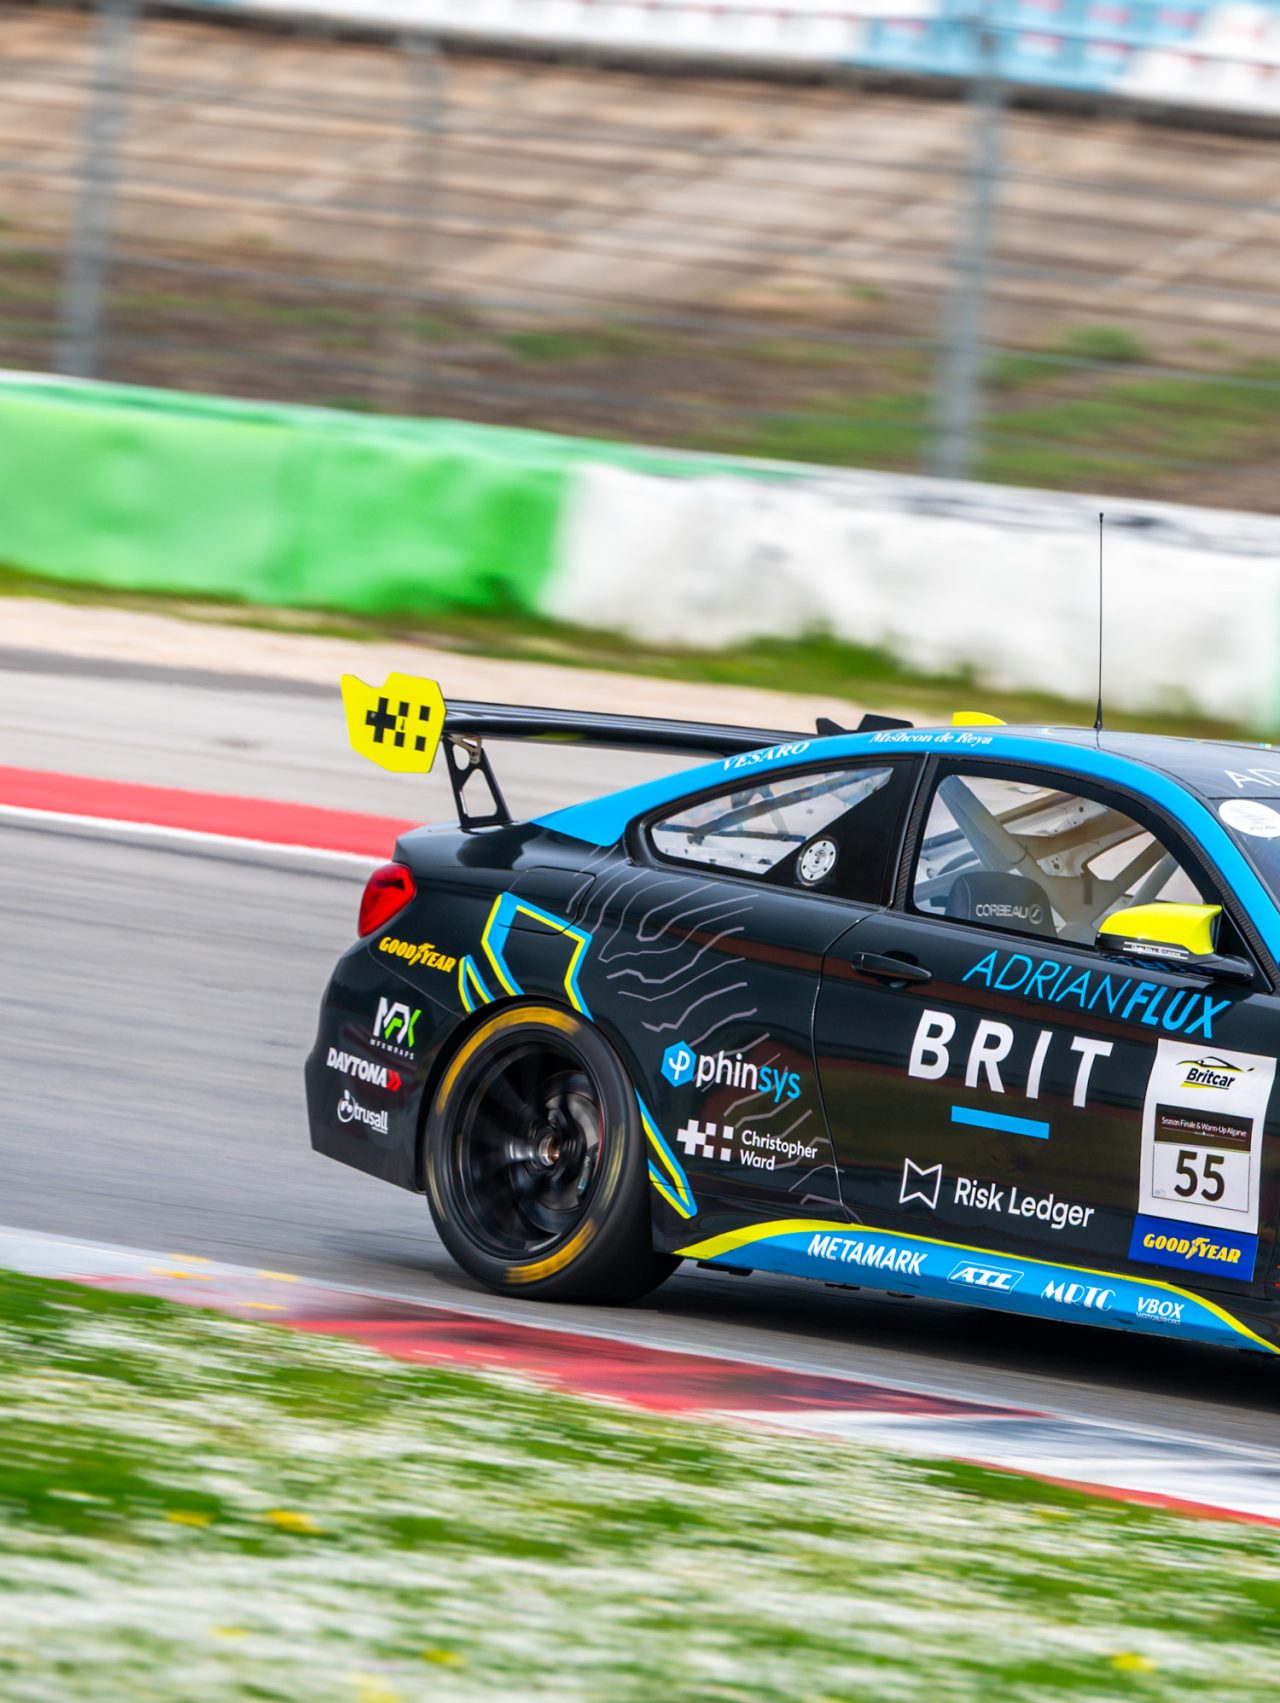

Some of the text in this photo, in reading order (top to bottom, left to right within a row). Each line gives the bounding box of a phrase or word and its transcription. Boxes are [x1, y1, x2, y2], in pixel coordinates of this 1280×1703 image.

[868, 731, 993, 747] Mishcon de Reya
[721, 742, 810, 772] VESARO
[975, 904, 1029, 919] CORBEAU
[379, 936, 457, 973] GOODYEAR
[327, 1047, 388, 1088] DAYTONA
[908, 1009, 1114, 1108] BRIT
[696, 1050, 801, 1103] phinsys
[1186, 1068, 1235, 1088] Britcar
[1161, 1116, 1180, 1126] Season
[740, 1149, 776, 1171] Ward
[741, 1129, 818, 1160] Christopher
[1174, 1149, 1226, 1202] 55
[953, 1177, 1095, 1229] Risk Ledger
[806, 1233, 928, 1278] METAMARK
[1143, 1232, 1241, 1264] GOODYEAR
[1137, 1296, 1185, 1319] VBOX
